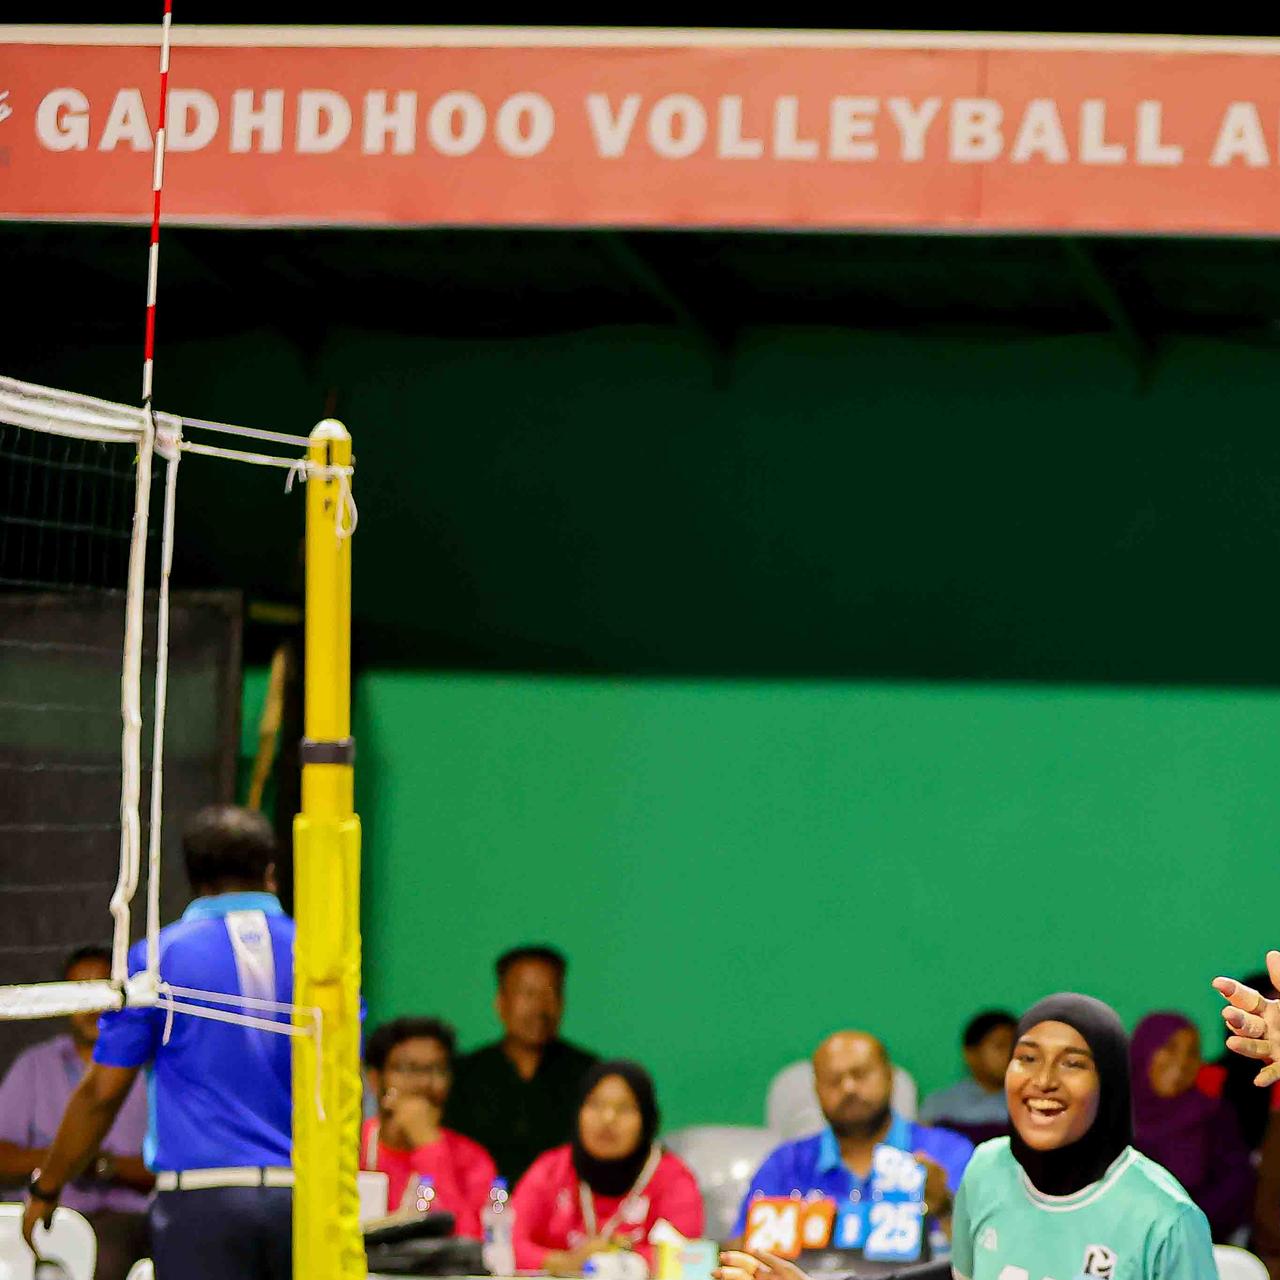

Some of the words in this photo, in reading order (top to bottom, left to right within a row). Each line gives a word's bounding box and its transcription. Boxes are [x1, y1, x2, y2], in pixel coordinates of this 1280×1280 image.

[35, 87, 556, 157] GADHDHOO
[587, 93, 1184, 166] VOLLEYBALL
[751, 1204, 798, 1252] 24
[866, 1201, 921, 1255] 25
